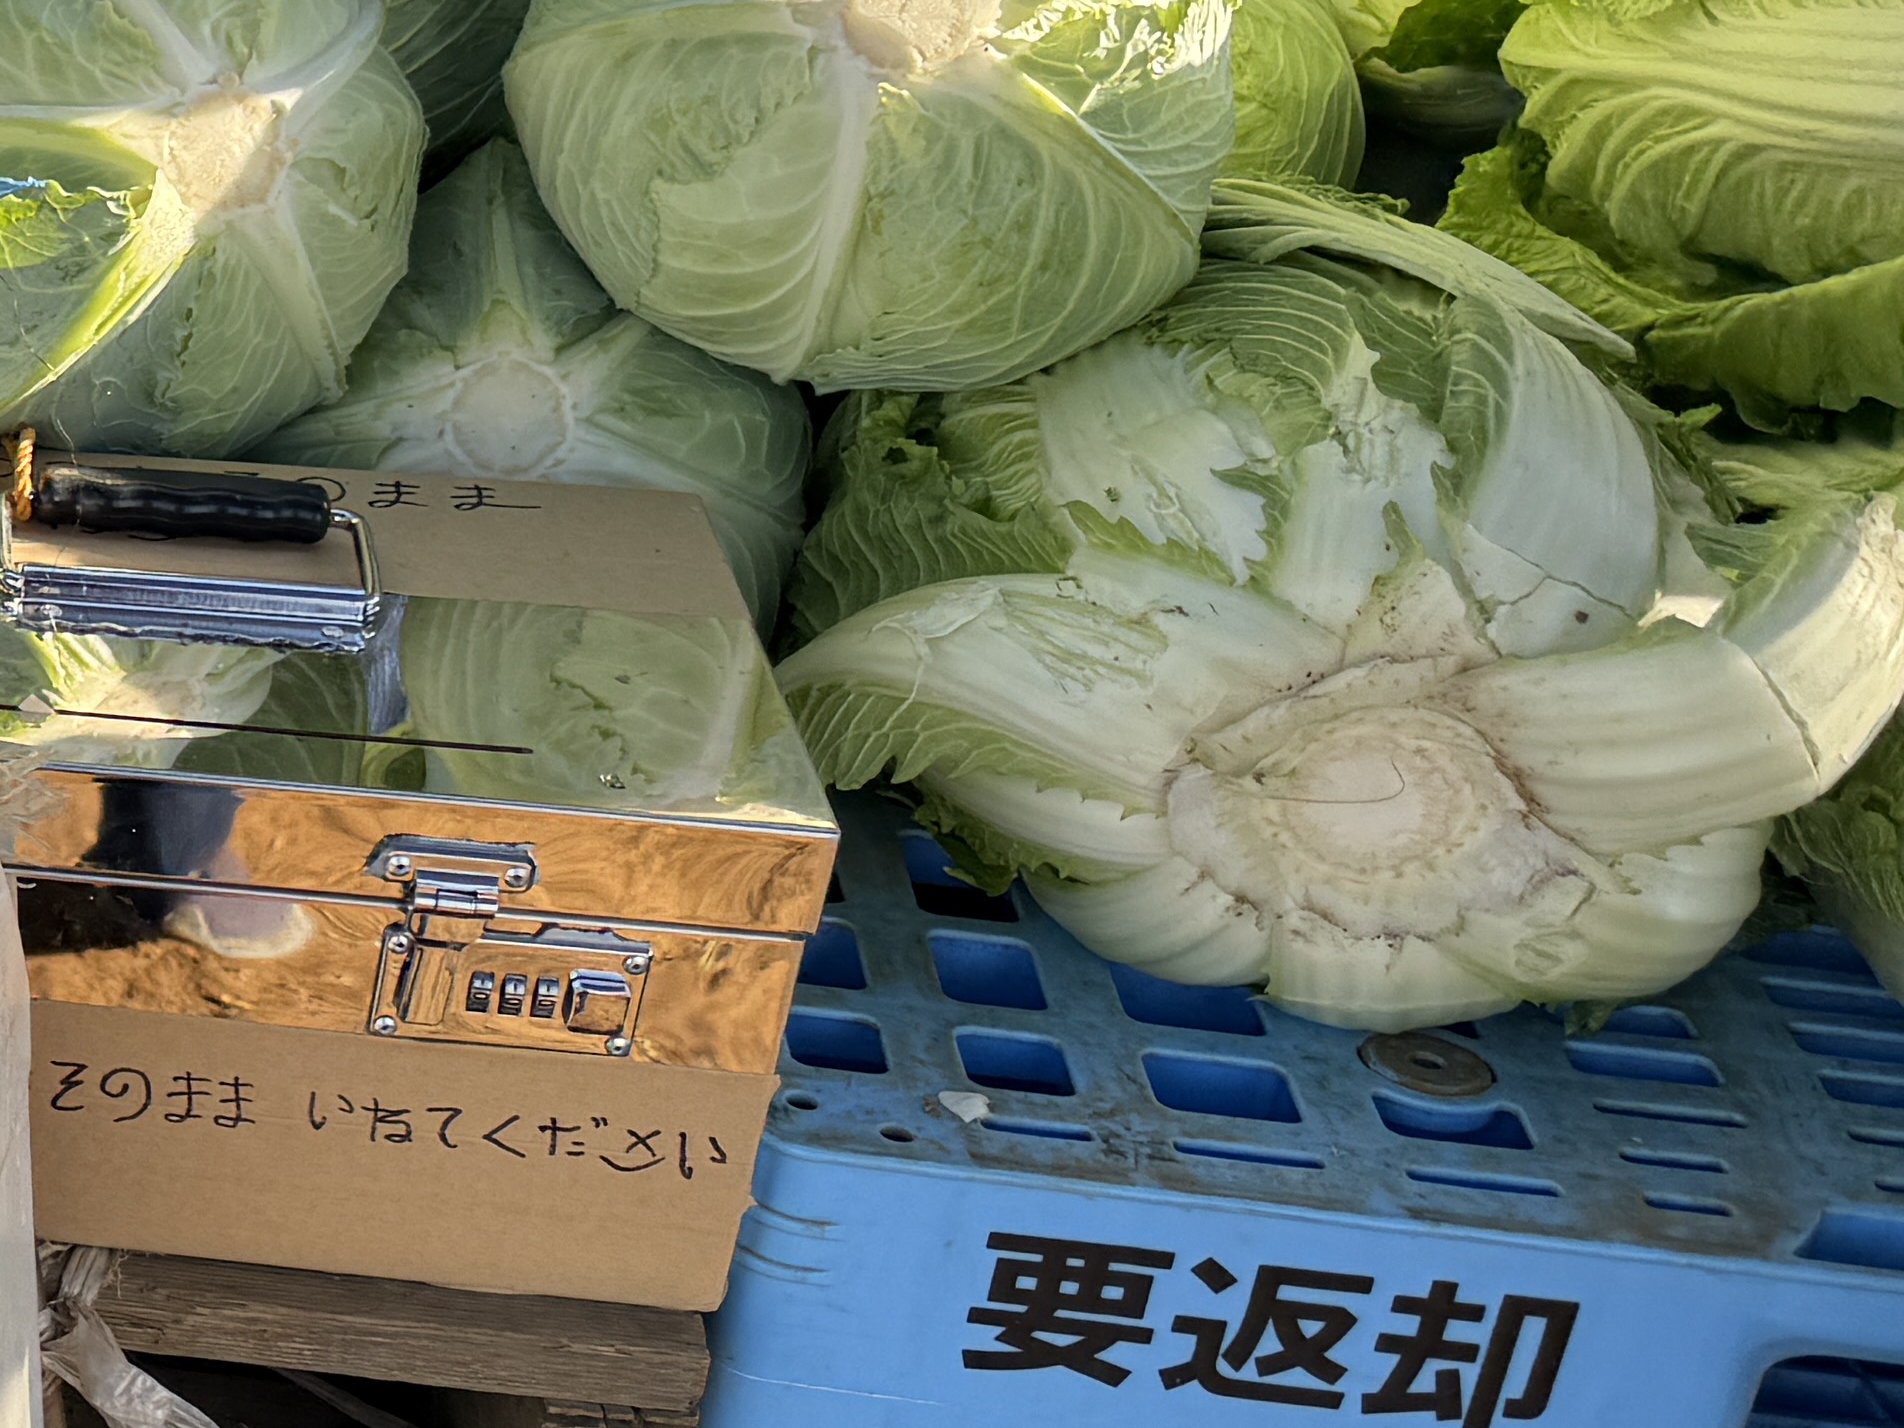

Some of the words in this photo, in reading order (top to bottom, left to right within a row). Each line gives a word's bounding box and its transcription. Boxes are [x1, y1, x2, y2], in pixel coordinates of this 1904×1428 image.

[49, 1059, 257, 1128] そのまま
[308, 1090, 729, 1180] いれてください
